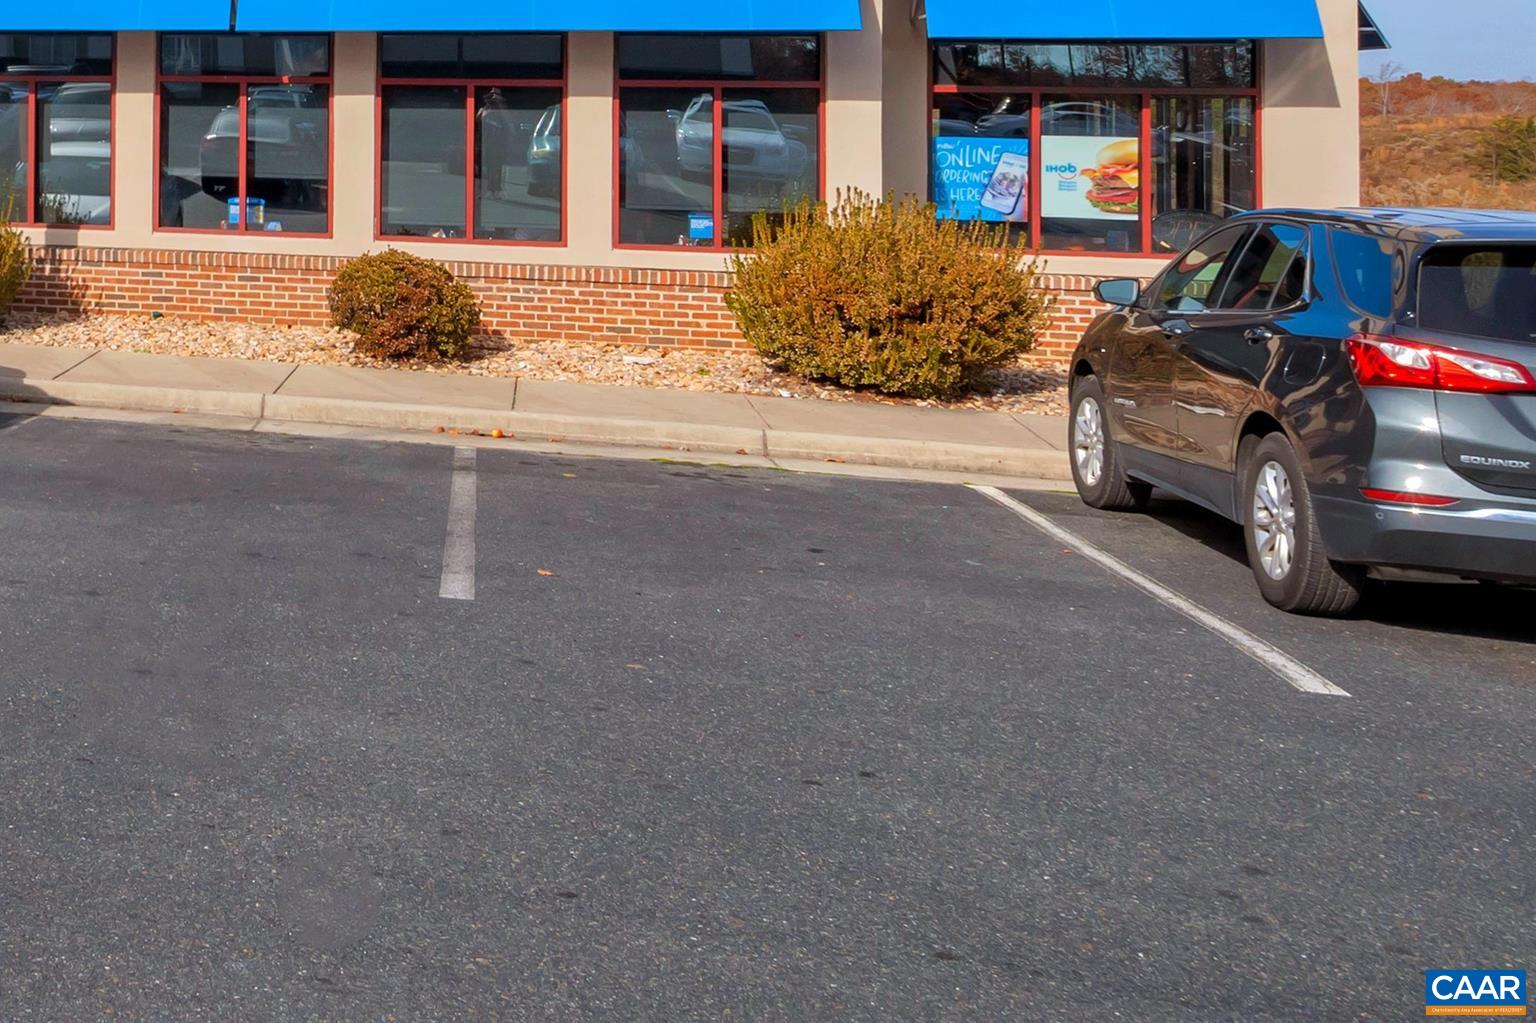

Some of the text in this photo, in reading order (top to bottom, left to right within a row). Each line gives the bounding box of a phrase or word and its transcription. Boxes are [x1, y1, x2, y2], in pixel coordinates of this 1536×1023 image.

[936, 144, 1002, 168] ONLINE
[935, 168, 993, 185] ORDERING
[1460, 454, 1531, 470] EQUINOX
